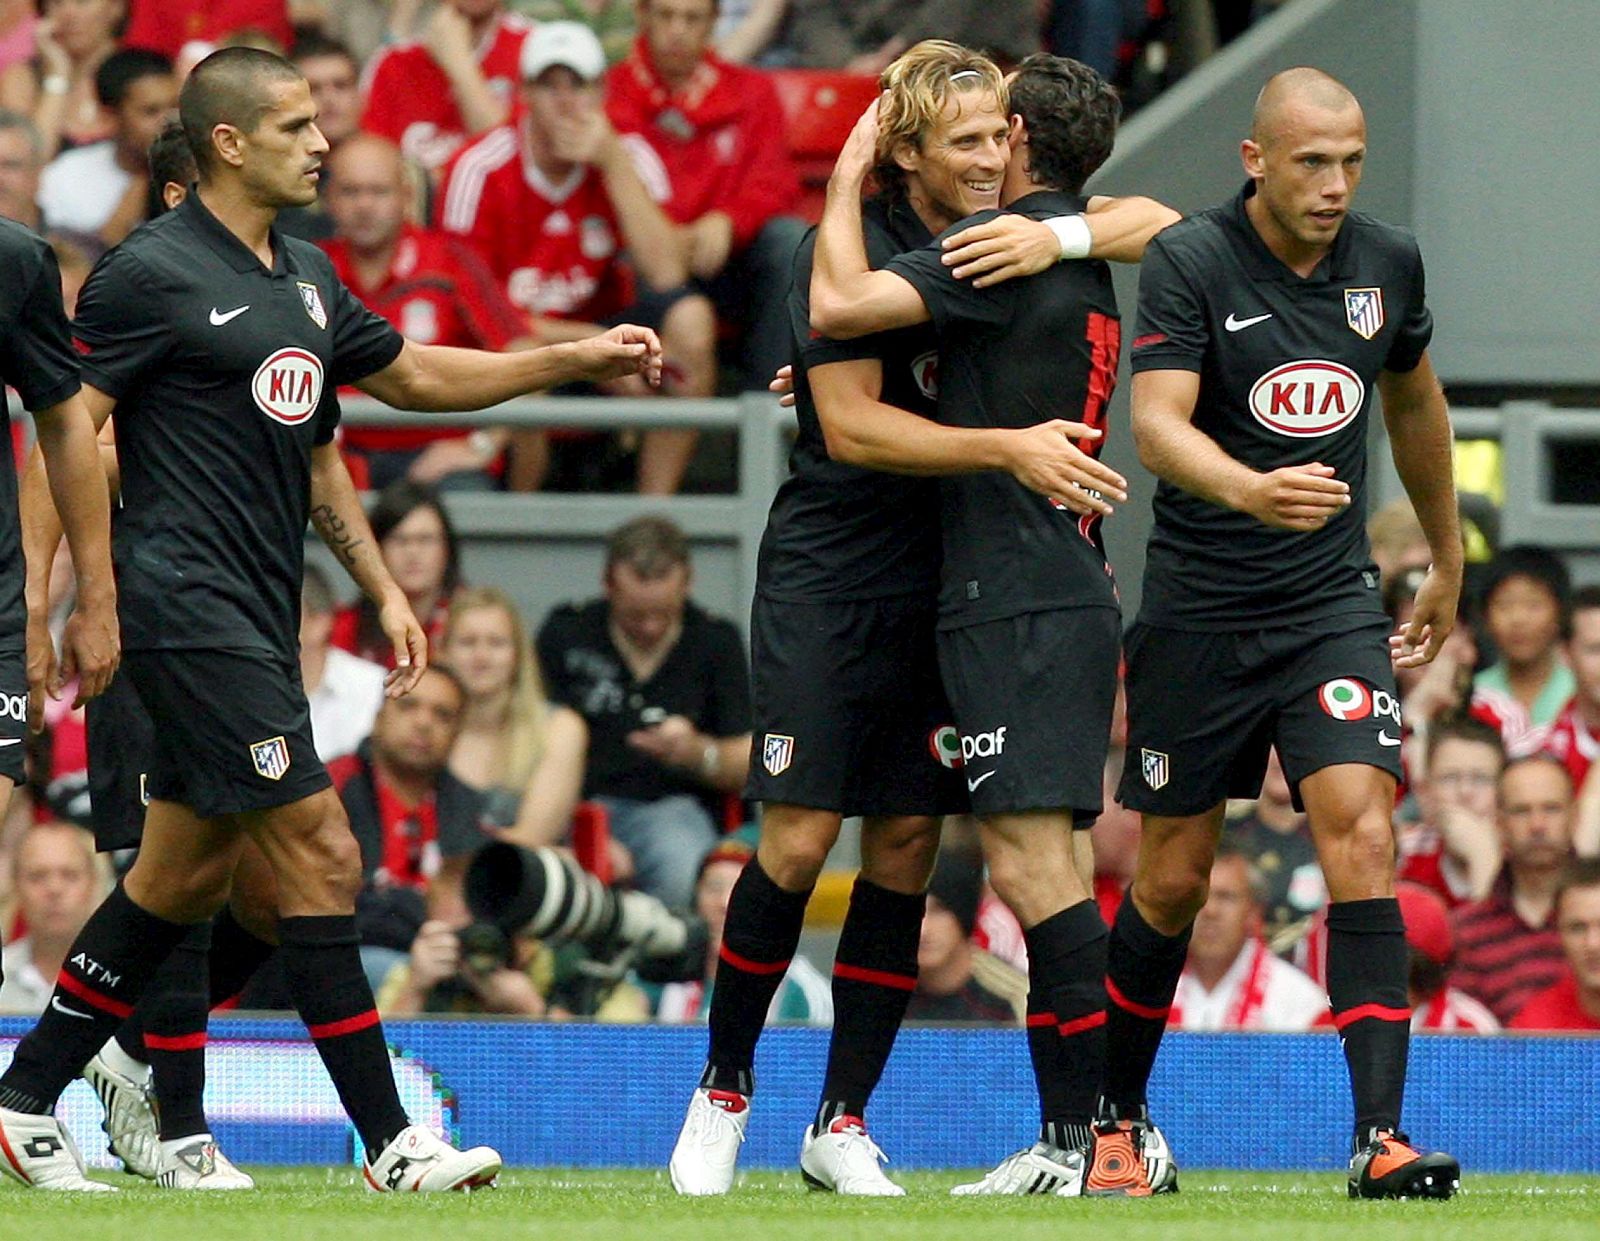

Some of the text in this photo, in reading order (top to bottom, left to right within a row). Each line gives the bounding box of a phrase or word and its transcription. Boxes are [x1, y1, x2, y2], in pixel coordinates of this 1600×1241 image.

[269, 367, 313, 405] KIA
[1269, 381, 1346, 416] KIA
[960, 725, 1007, 766] paf
[70, 952, 121, 988] ATM
